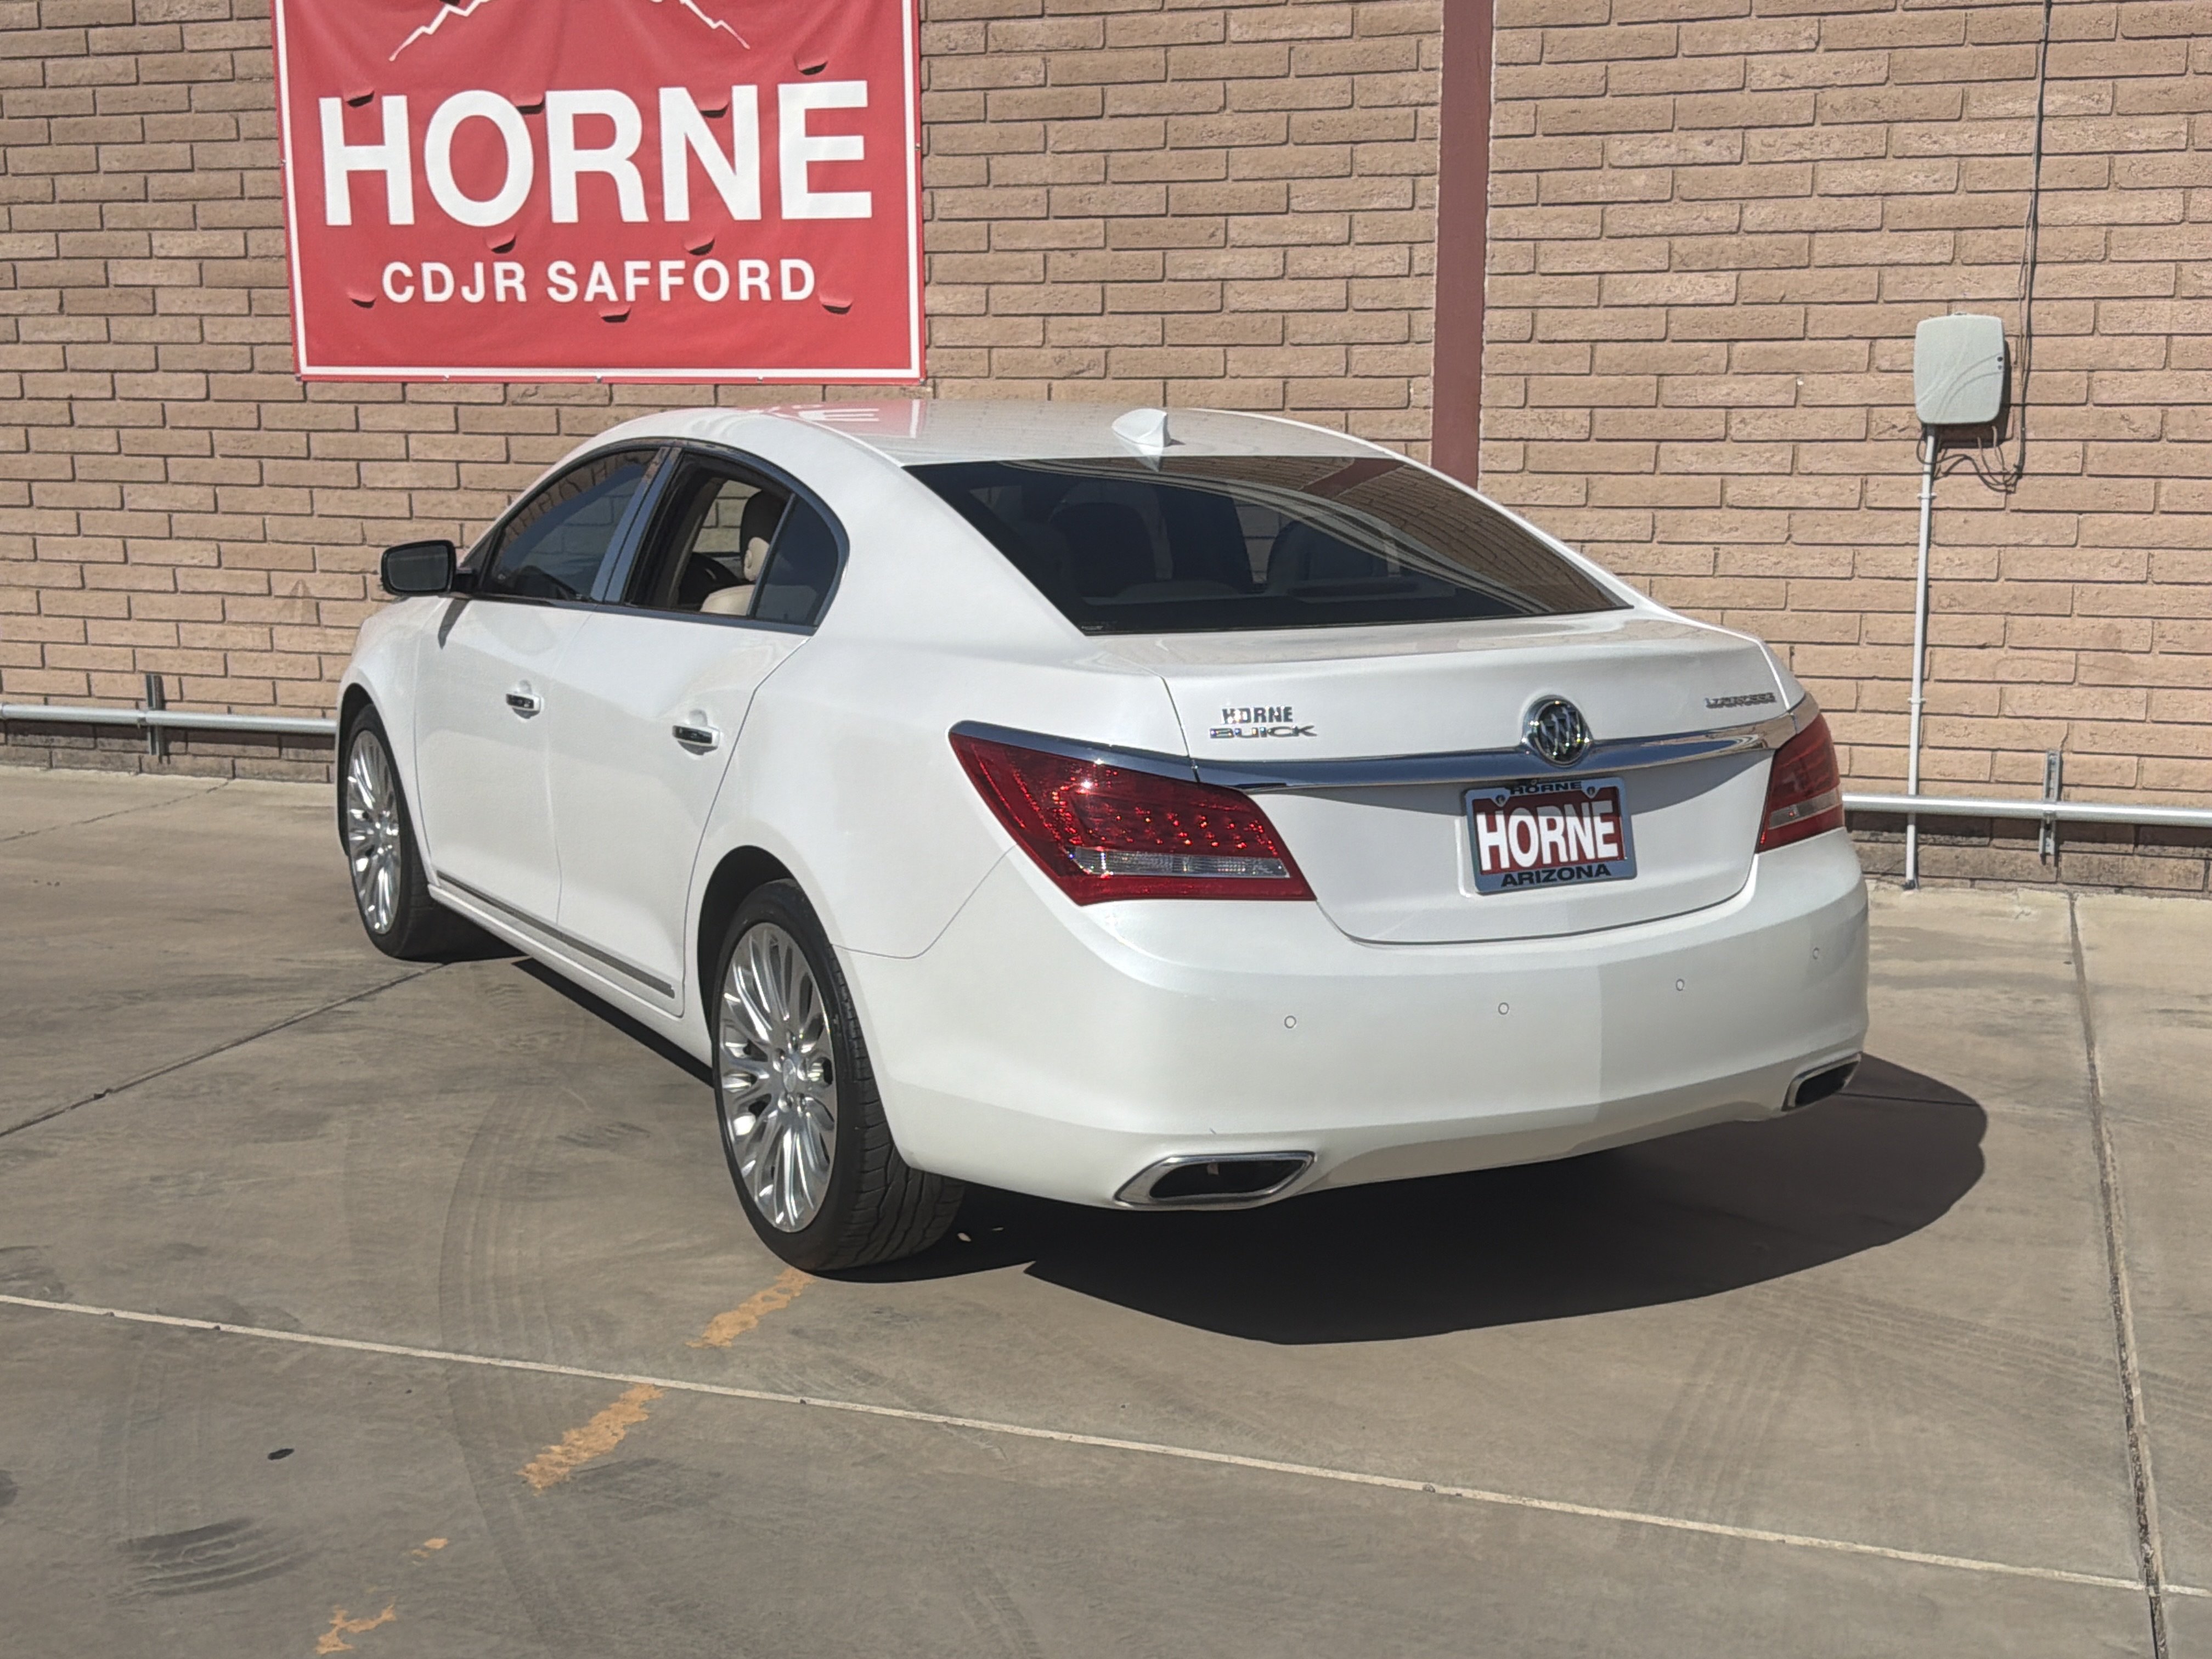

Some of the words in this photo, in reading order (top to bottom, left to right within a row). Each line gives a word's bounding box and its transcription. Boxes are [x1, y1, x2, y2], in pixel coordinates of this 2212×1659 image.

[319, 80, 872, 227] HORNE
[382, 262, 527, 303] CDJR
[547, 259, 815, 302] SAFFORD
[1221, 706, 1293, 724] HORNE
[1209, 725, 1317, 738] BUICK
[1510, 781, 1582, 795] HORNE
[1476, 800, 1618, 871] HORNE
[1500, 864, 1611, 887] ARIZONA
